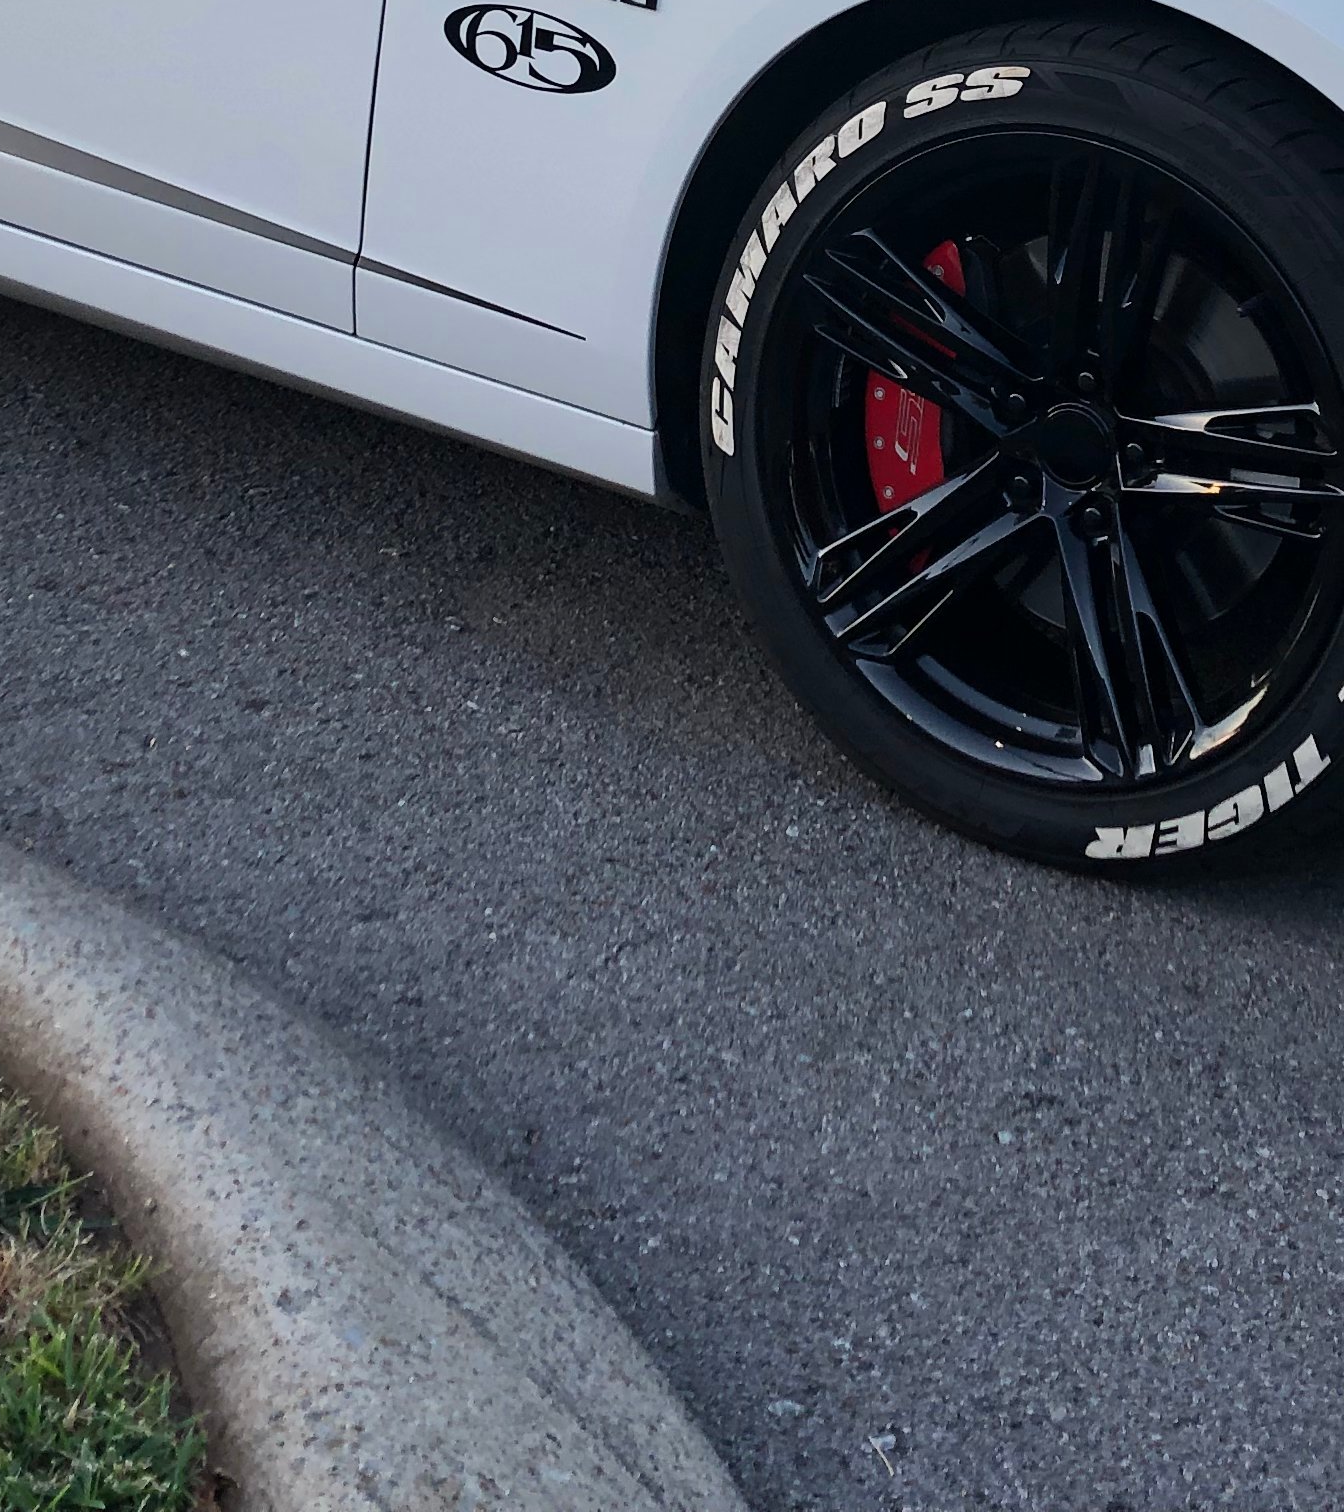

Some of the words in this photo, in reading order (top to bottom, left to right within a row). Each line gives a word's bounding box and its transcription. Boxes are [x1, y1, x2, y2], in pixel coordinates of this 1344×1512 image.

[451, 5, 611, 92] 615
[711, 101, 886, 457] CAMARO
[903, 66, 1031, 119] SS
[1085, 734, 1332, 860] TIGER
